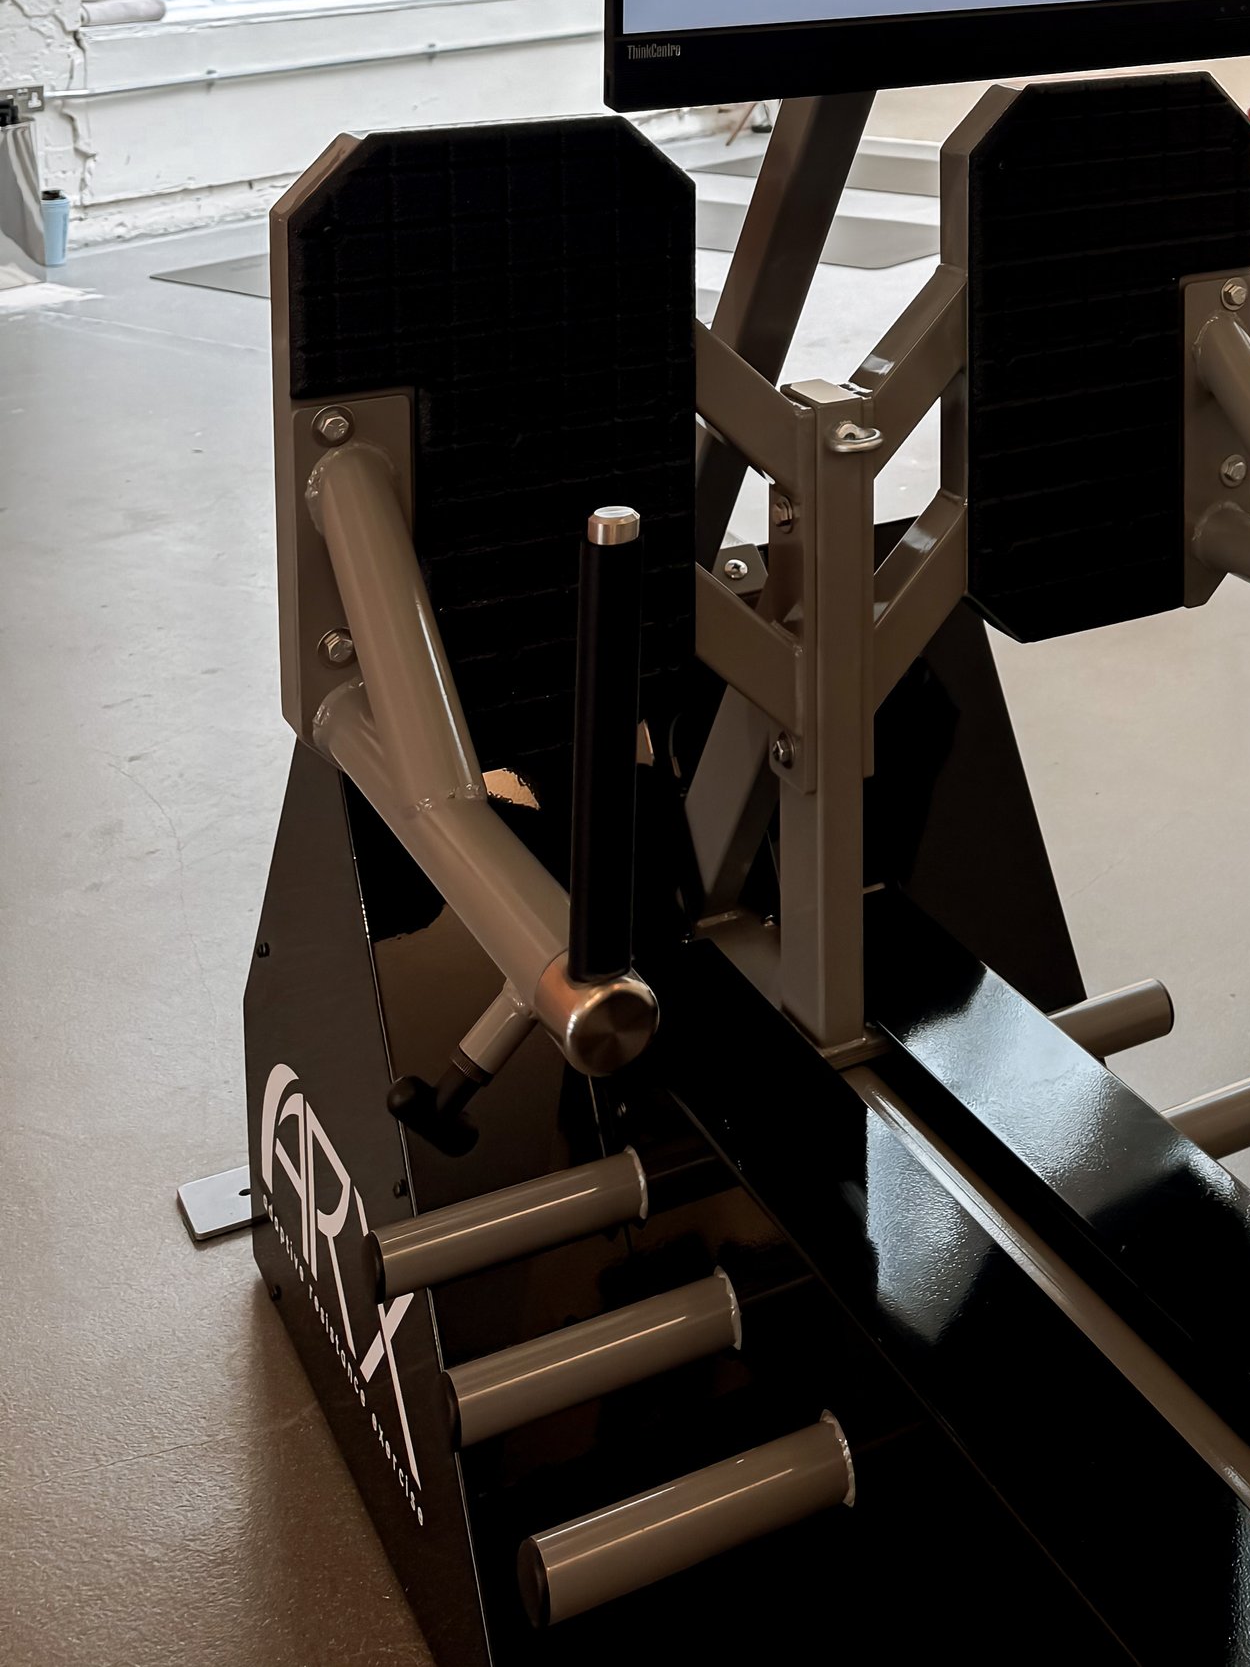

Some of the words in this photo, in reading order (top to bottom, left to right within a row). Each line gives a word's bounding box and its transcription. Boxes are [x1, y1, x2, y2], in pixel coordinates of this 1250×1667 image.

[261, 1063, 422, 1492] ARX
[308, 1284, 367, 1407] resistance
[371, 1412, 424, 1526] exercise
